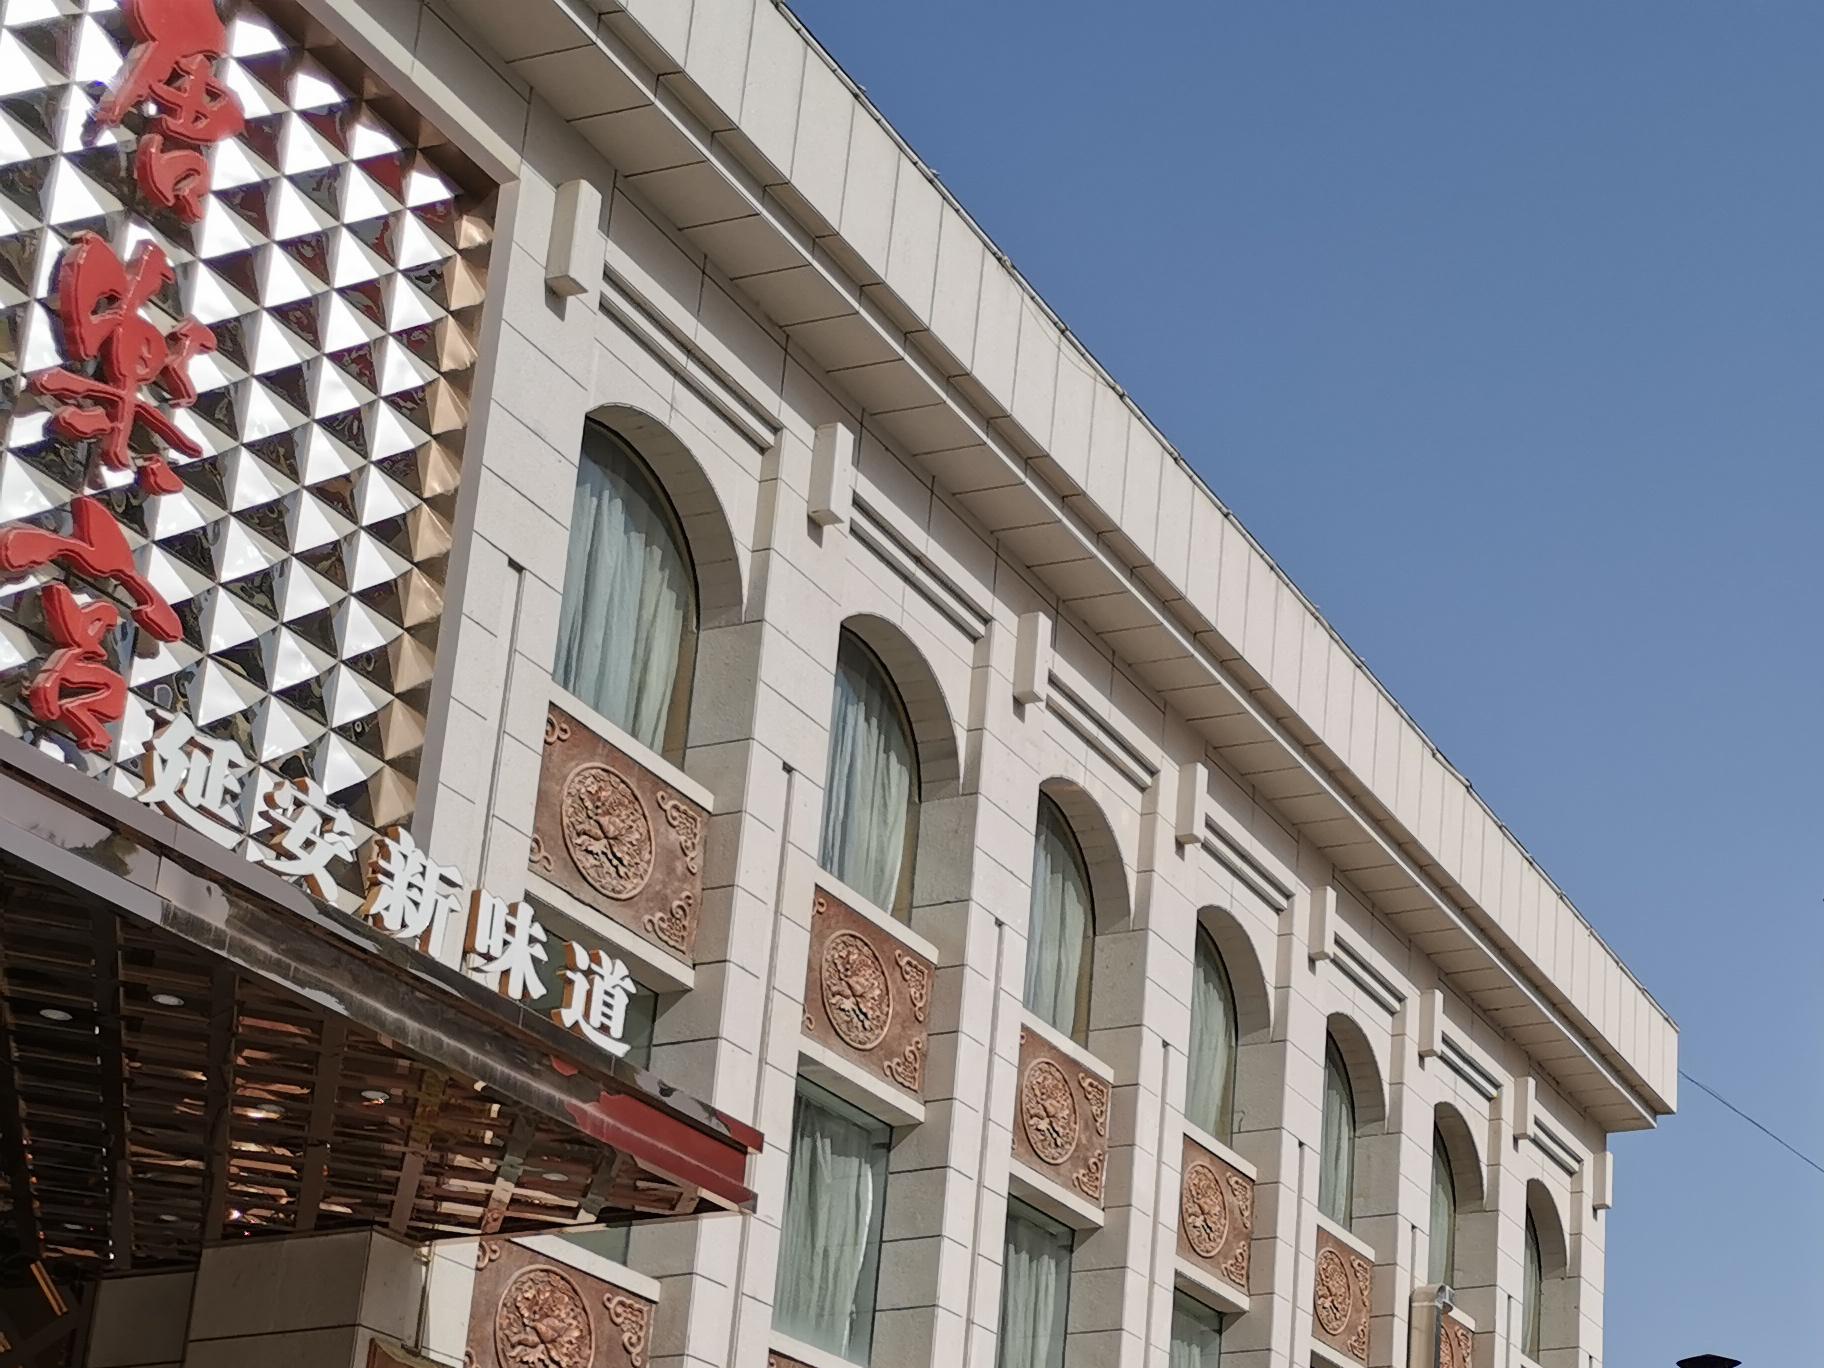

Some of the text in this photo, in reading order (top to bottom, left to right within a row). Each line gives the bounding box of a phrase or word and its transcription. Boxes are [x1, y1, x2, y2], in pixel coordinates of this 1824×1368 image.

[136, 712, 637, 1058] 延安新味道
